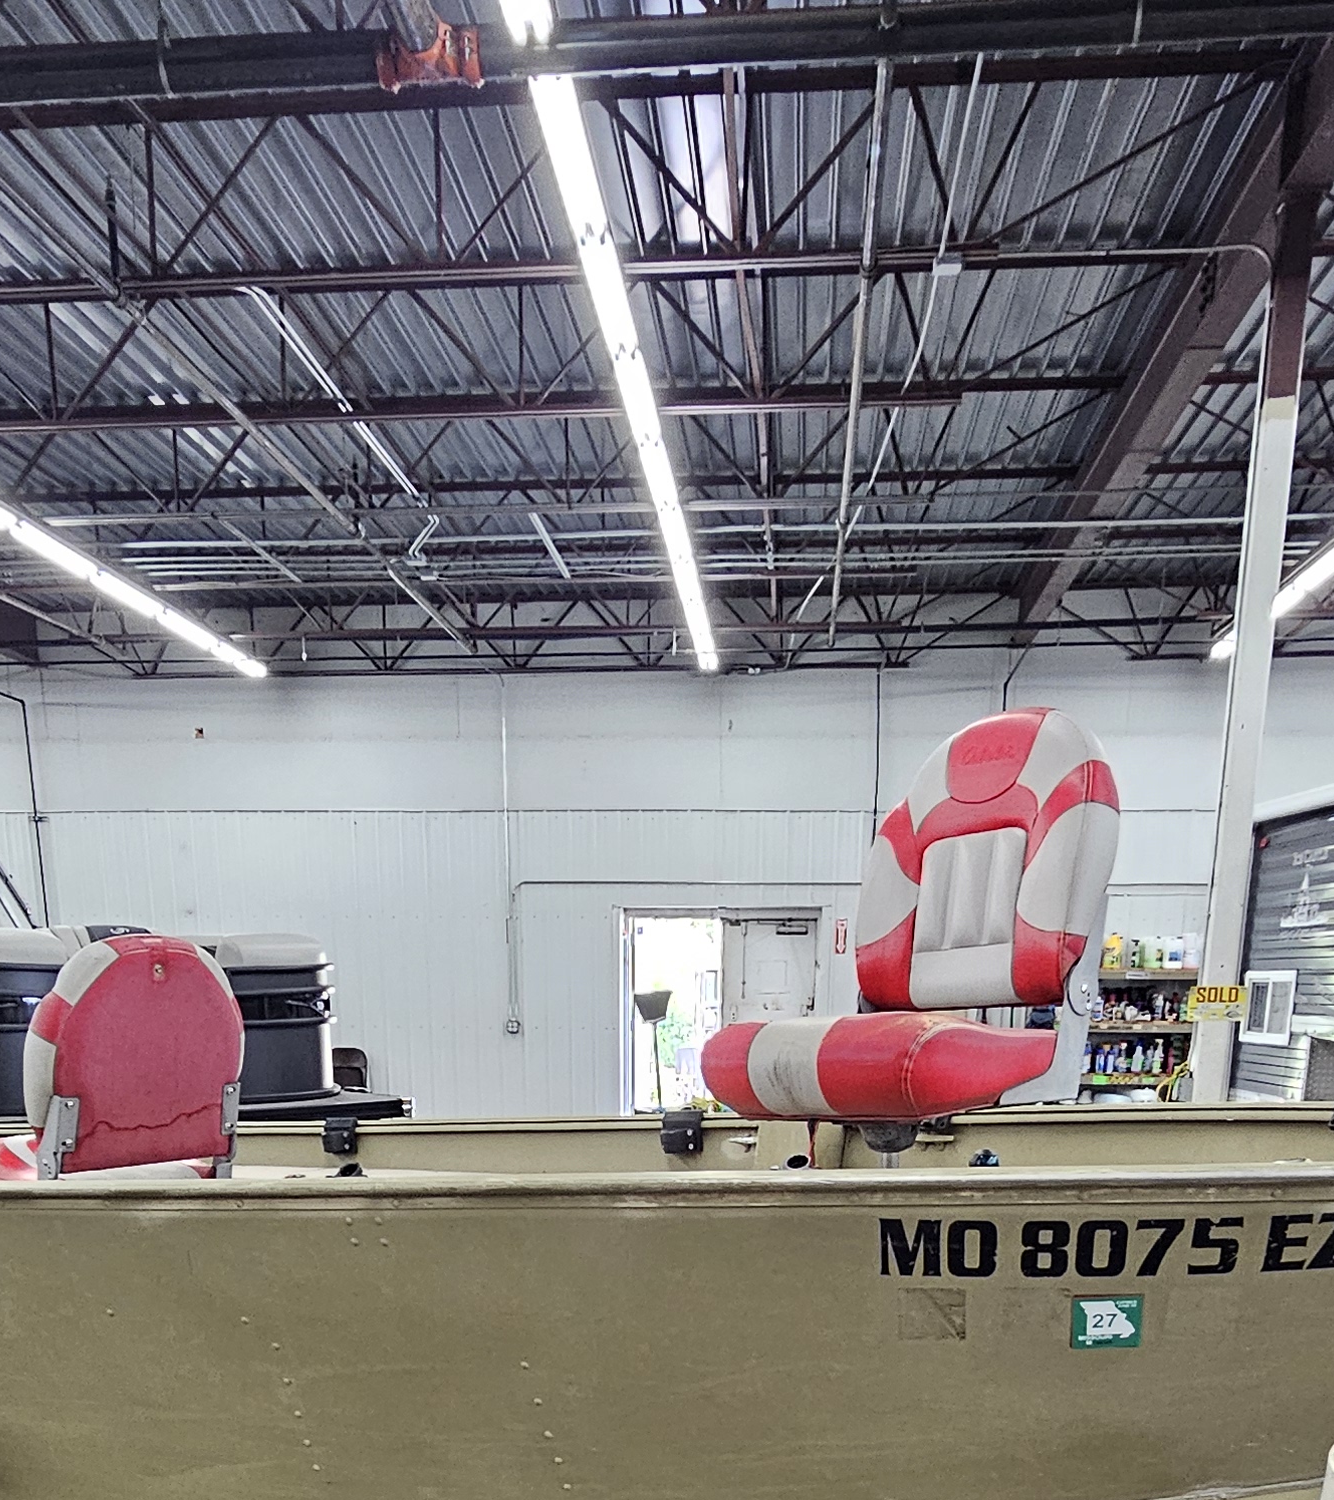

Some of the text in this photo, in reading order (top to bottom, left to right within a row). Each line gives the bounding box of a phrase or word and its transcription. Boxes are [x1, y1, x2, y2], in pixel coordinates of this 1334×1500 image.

[1196, 987, 1239, 1003] SOLD
[879, 1218, 998, 1277] MO
[1020, 1216, 1245, 1277] 8075
[1092, 1313, 1118, 1328] 27
